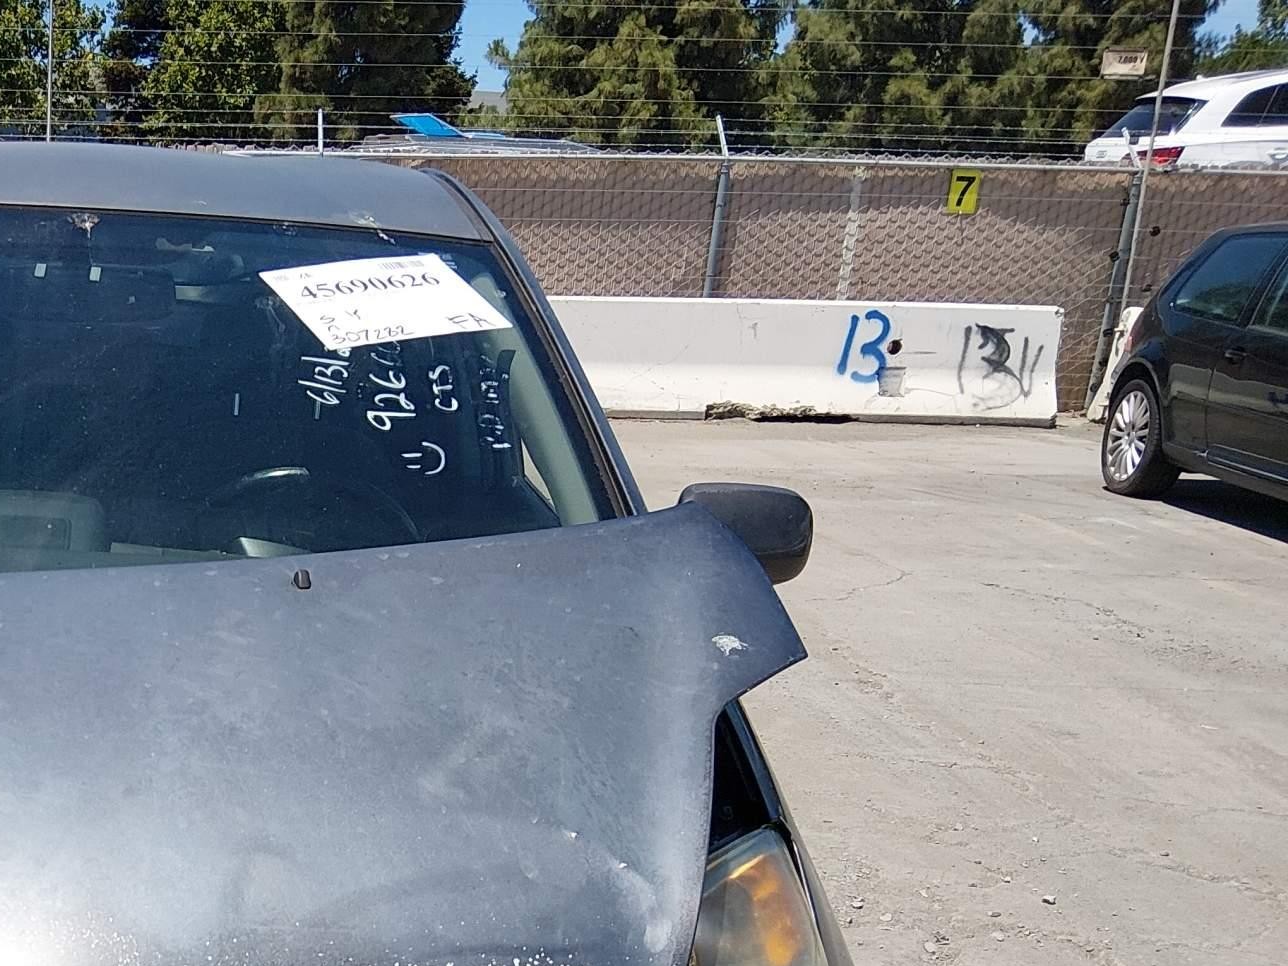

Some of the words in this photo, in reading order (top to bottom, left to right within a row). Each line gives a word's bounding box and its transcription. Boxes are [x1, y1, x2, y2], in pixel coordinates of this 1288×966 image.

[955, 175, 977, 207] 7
[300, 271, 441, 300] 45690626
[836, 309, 892, 384] 13
